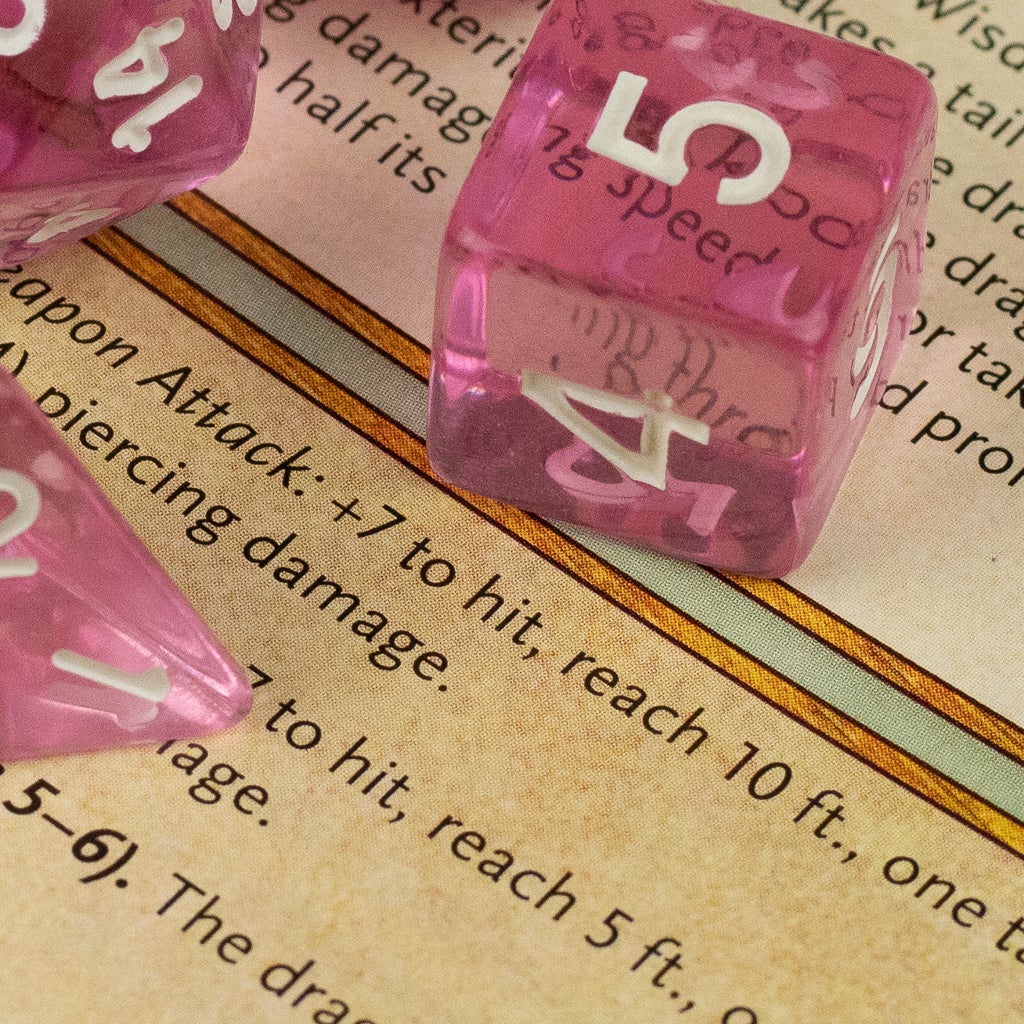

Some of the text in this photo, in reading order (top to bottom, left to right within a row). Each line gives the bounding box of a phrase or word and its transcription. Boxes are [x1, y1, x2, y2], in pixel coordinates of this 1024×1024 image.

[93, 17, 203, 153] 14
[276, 59, 448, 194] half its
[318, 13, 492, 144] damag
[586, 71, 792, 206] 5
[521, 369, 711, 491] 4
[36, 385, 451, 694] piercing damage.
[137, 364, 327, 498] Attack:
[331, 497, 407, 541] +7
[399, 537, 456, 587] to
[461, 574, 541, 663] hit,
[560, 649, 710, 757] reach
[724, 740, 794, 801] 10
[792, 789, 860, 865] ft.,
[882, 855, 988, 929] one
[265, 698, 696, 1015] to hit, reach 5 ft.,
[156, 872, 253, 965] The
[259, 960, 376, 1024] dra
